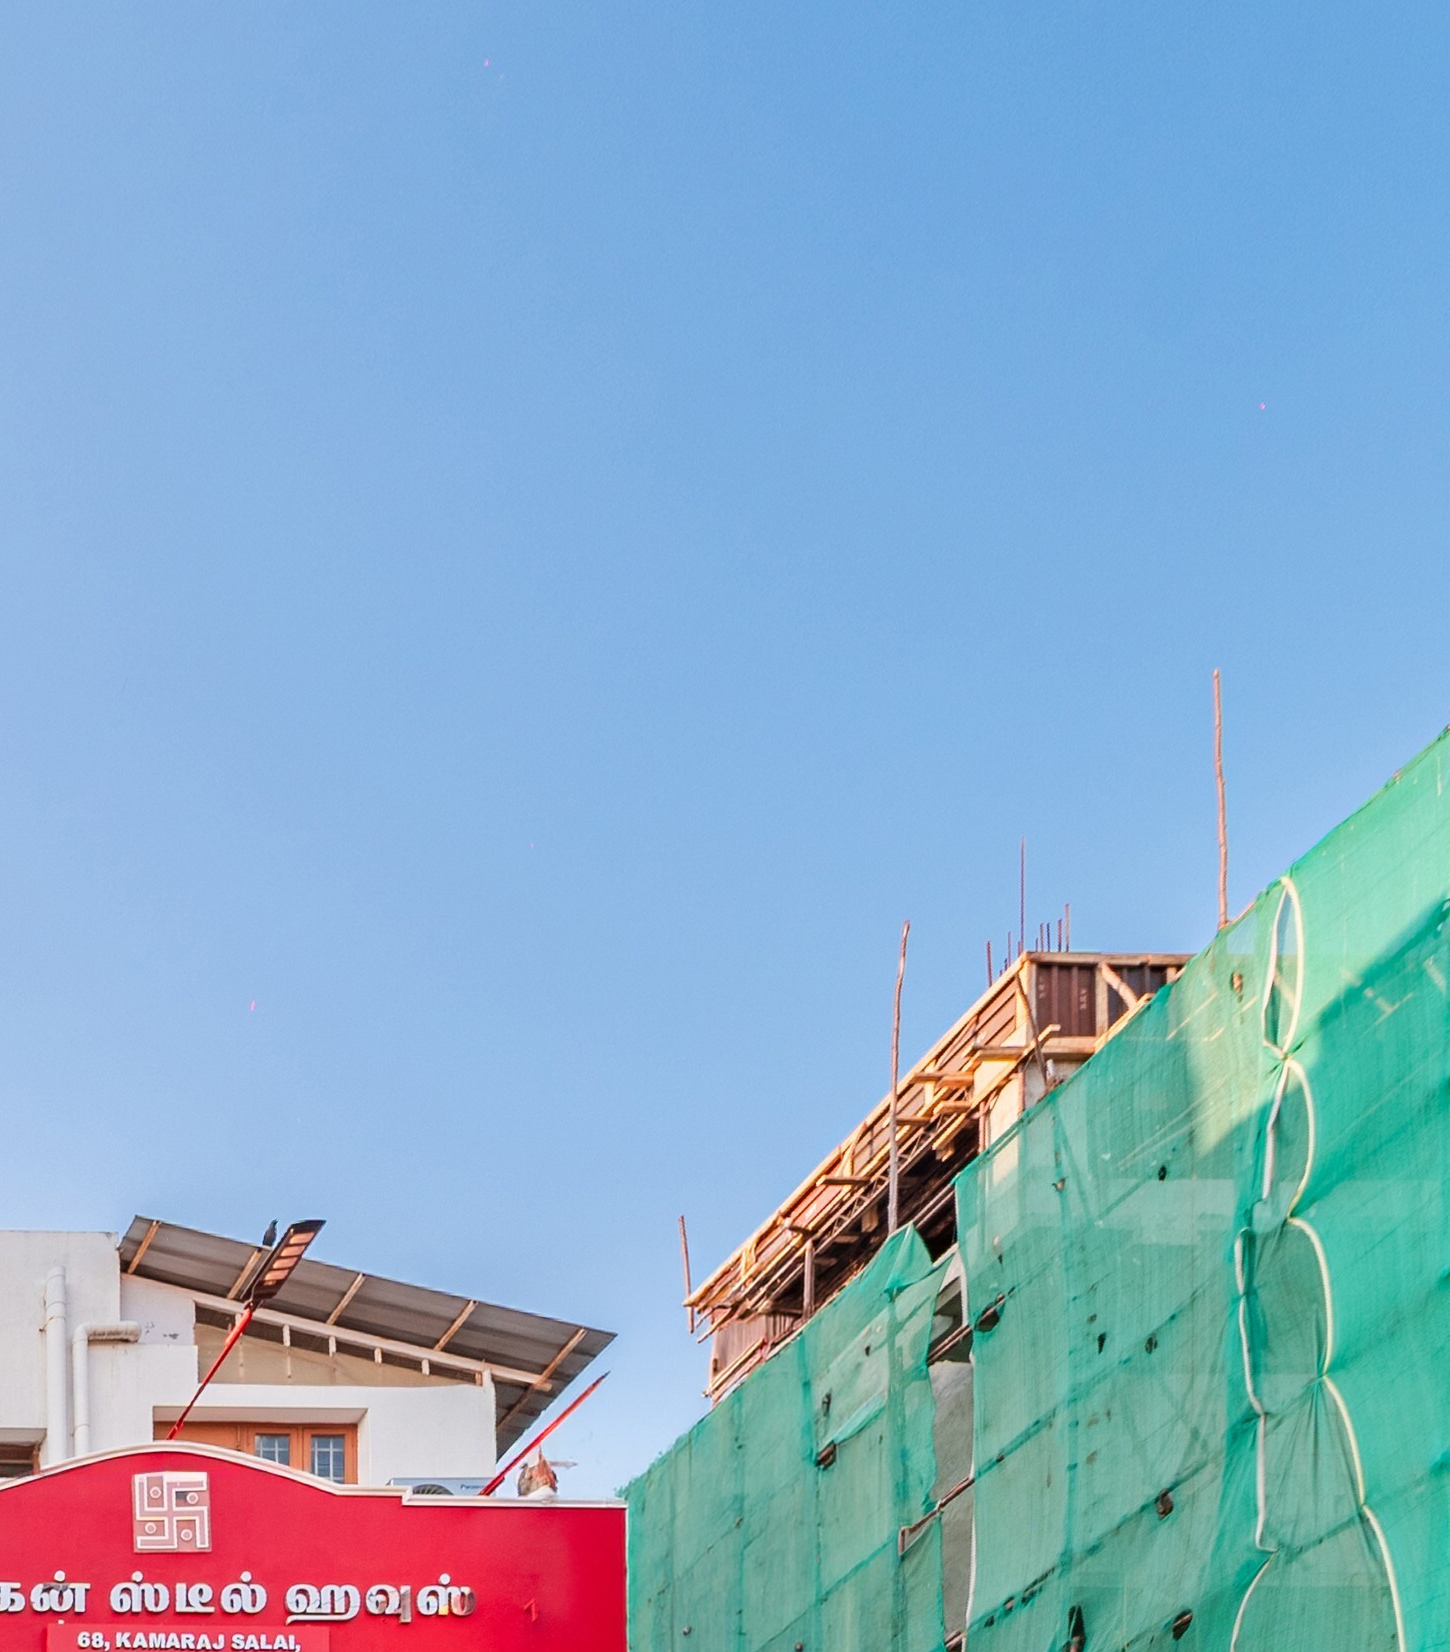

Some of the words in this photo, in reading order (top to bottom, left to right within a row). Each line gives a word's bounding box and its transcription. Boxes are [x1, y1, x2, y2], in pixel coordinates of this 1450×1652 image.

[109, 1571, 268, 1615] ஸ்டீல்
[285, 1573, 476, 1625] ஹவுஸ்
[78, 1631, 111, 1652] 68,
[116, 1632, 225, 1652] KAMARAJ
